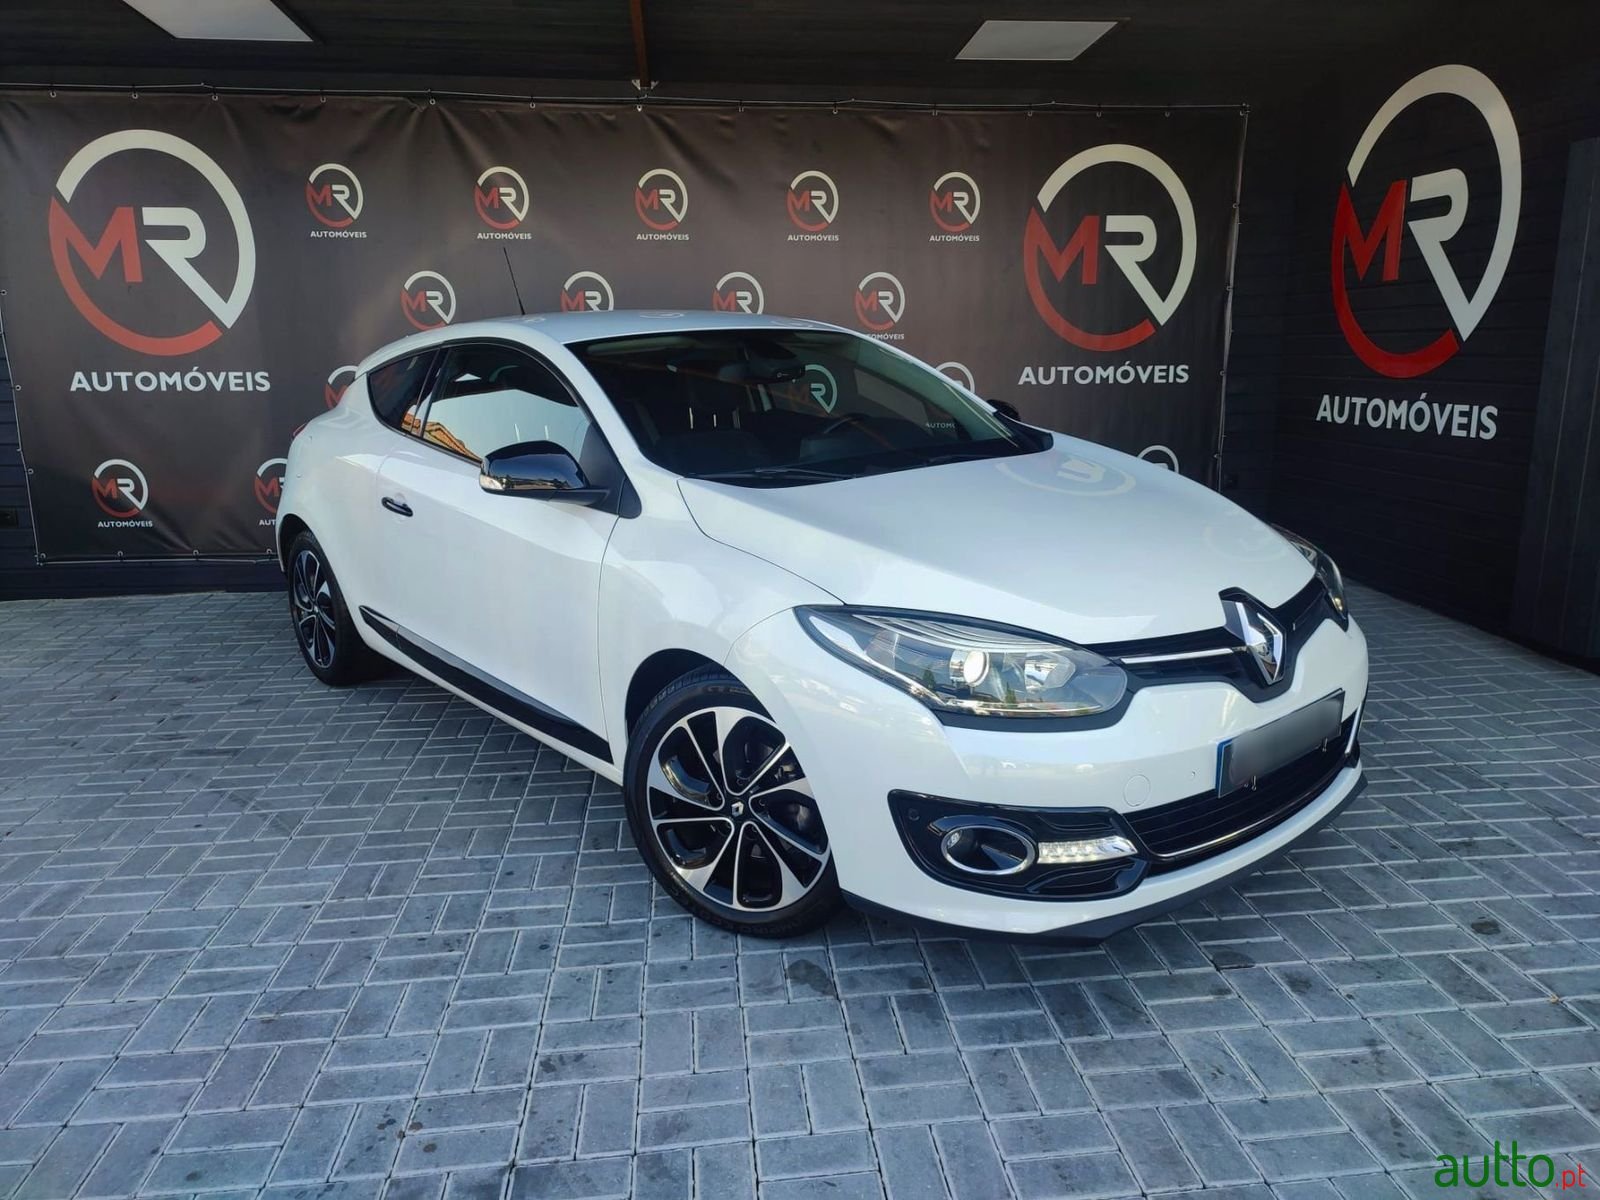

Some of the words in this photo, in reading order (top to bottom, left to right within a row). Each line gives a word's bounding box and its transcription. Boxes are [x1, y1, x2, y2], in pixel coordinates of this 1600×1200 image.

[310, 230, 367, 239] AUTOMÓVEIS
[476, 231, 532, 240] AUTOMÓVEIS
[636, 232, 690, 241] AUTOMÓVEIS
[787, 233, 839, 242] AUTOMÓVEIS
[929, 233, 980, 242] AUTOMÓVEIS
[867, 332, 905, 340] OMÓVEIS
[1018, 360, 1189, 385] AUTOMÓVEIS
[69, 366, 271, 392] AUTOMÓVEIS
[1315, 392, 1498, 440] AUTOMÓVEIS
[98, 520, 153, 528] AUTOMÓVEIS
